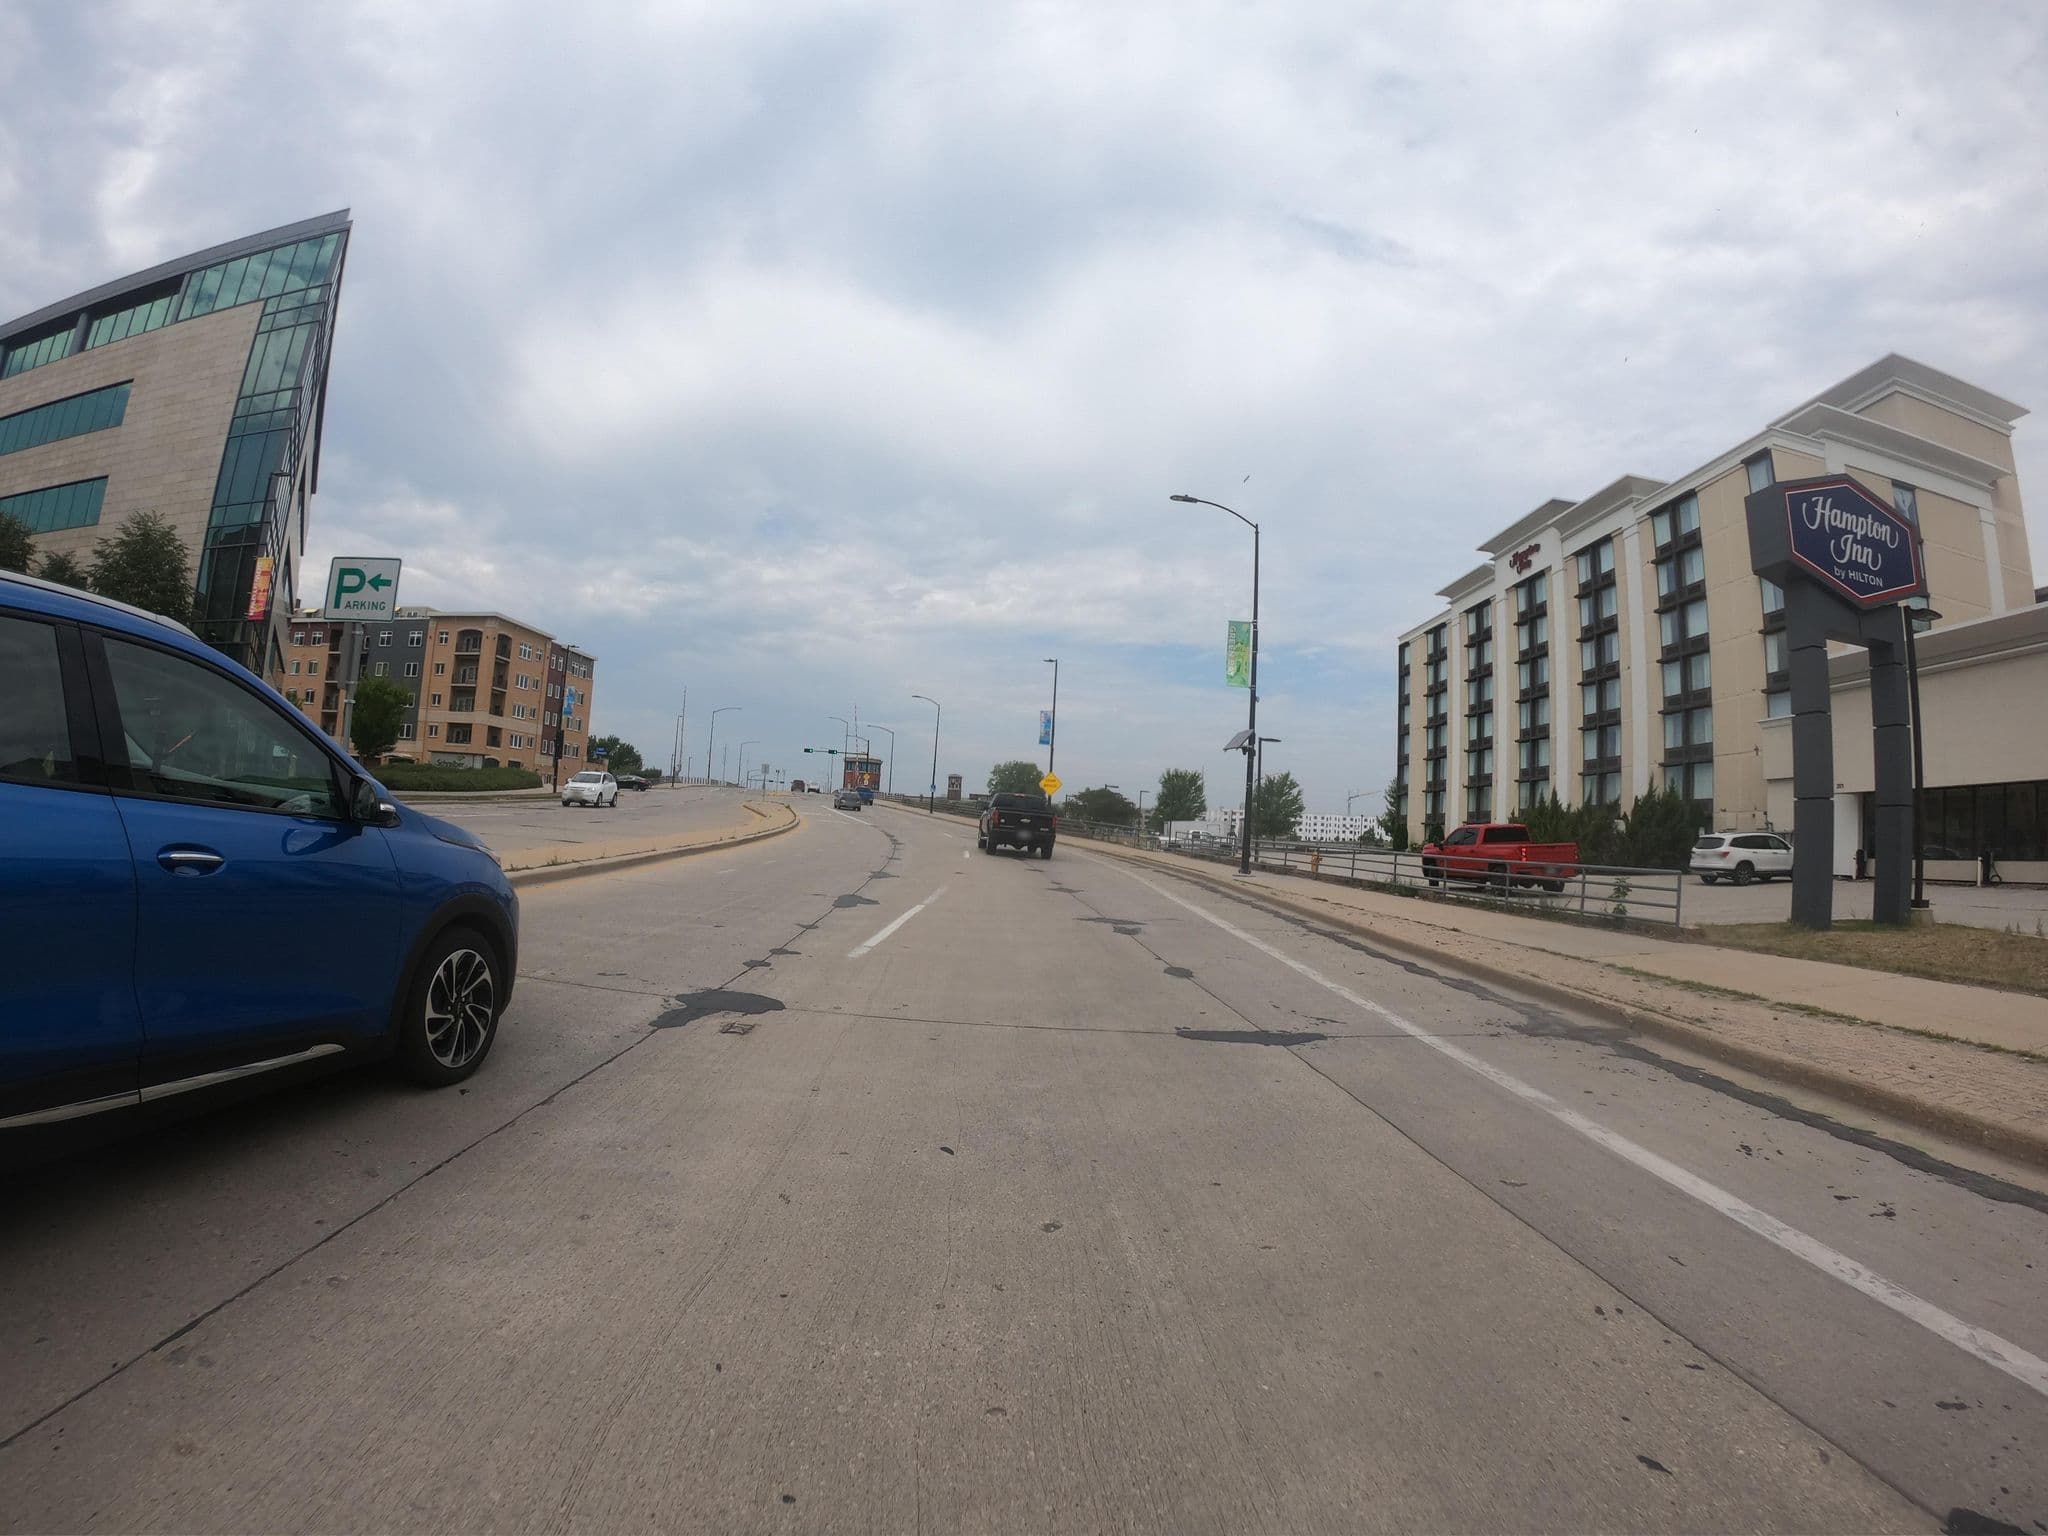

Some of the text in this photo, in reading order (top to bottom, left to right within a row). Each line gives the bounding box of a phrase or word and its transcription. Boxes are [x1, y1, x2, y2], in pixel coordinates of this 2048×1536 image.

[1803, 497, 1899, 549] Hampton
[1830, 535, 1882, 571] Inn
[1834, 566, 1883, 588] by HILTON
